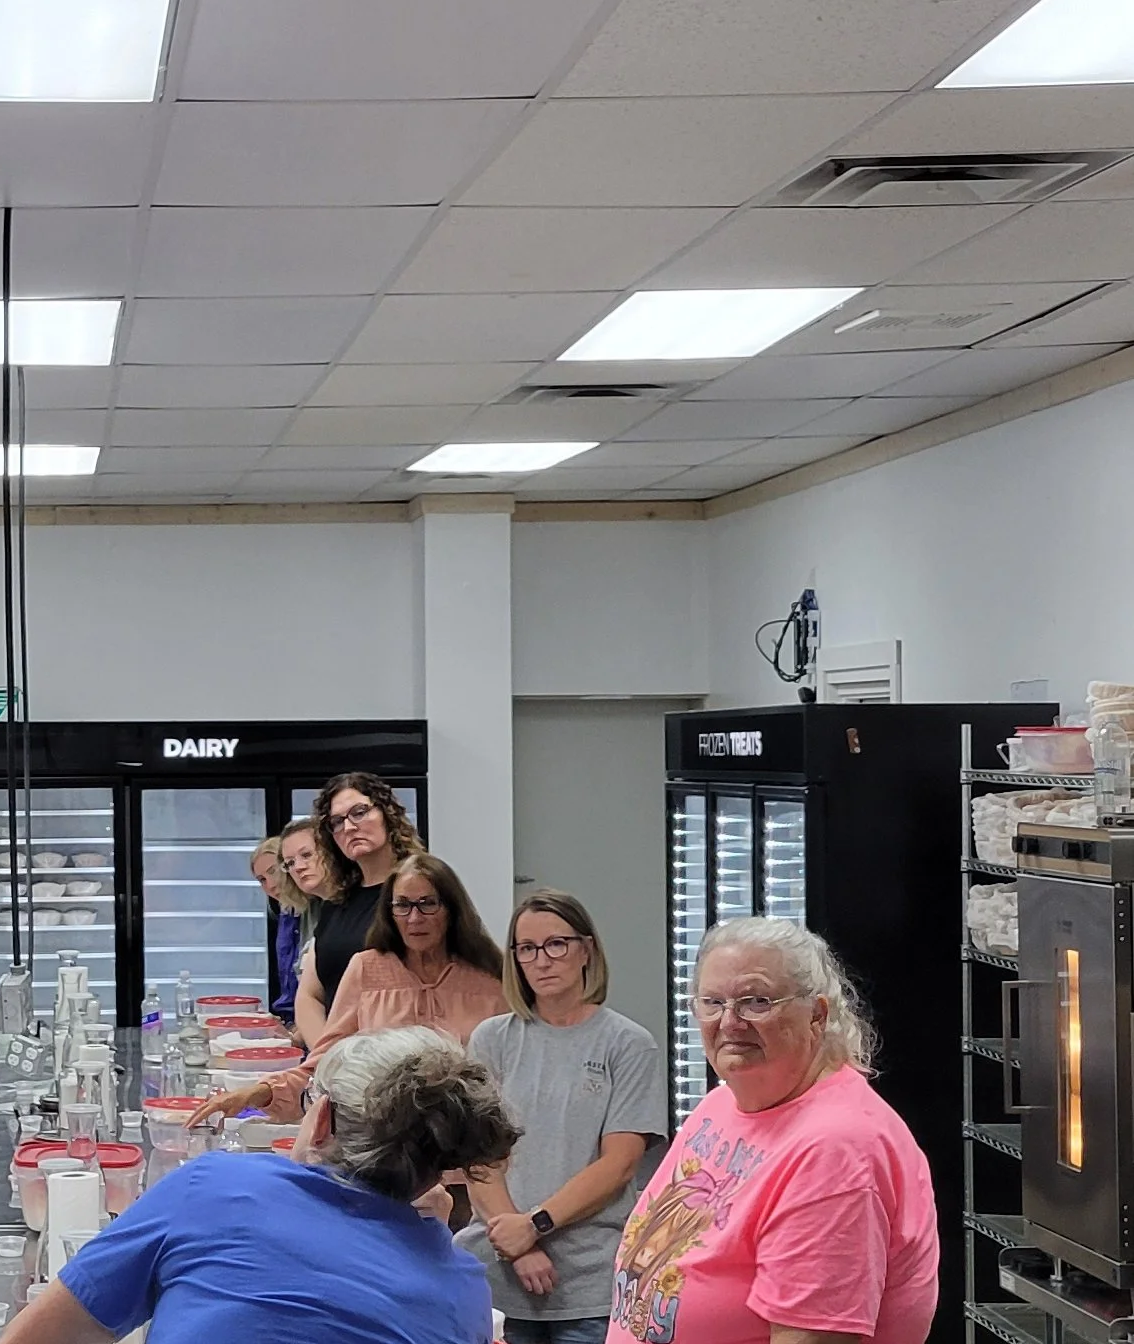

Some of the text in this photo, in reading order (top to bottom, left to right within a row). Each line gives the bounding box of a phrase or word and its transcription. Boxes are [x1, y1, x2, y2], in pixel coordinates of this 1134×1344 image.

[163, 738, 240, 758] DAIRY
[698, 731, 762, 757] FROZEN TREATS
[714, 1140, 730, 1168] a
